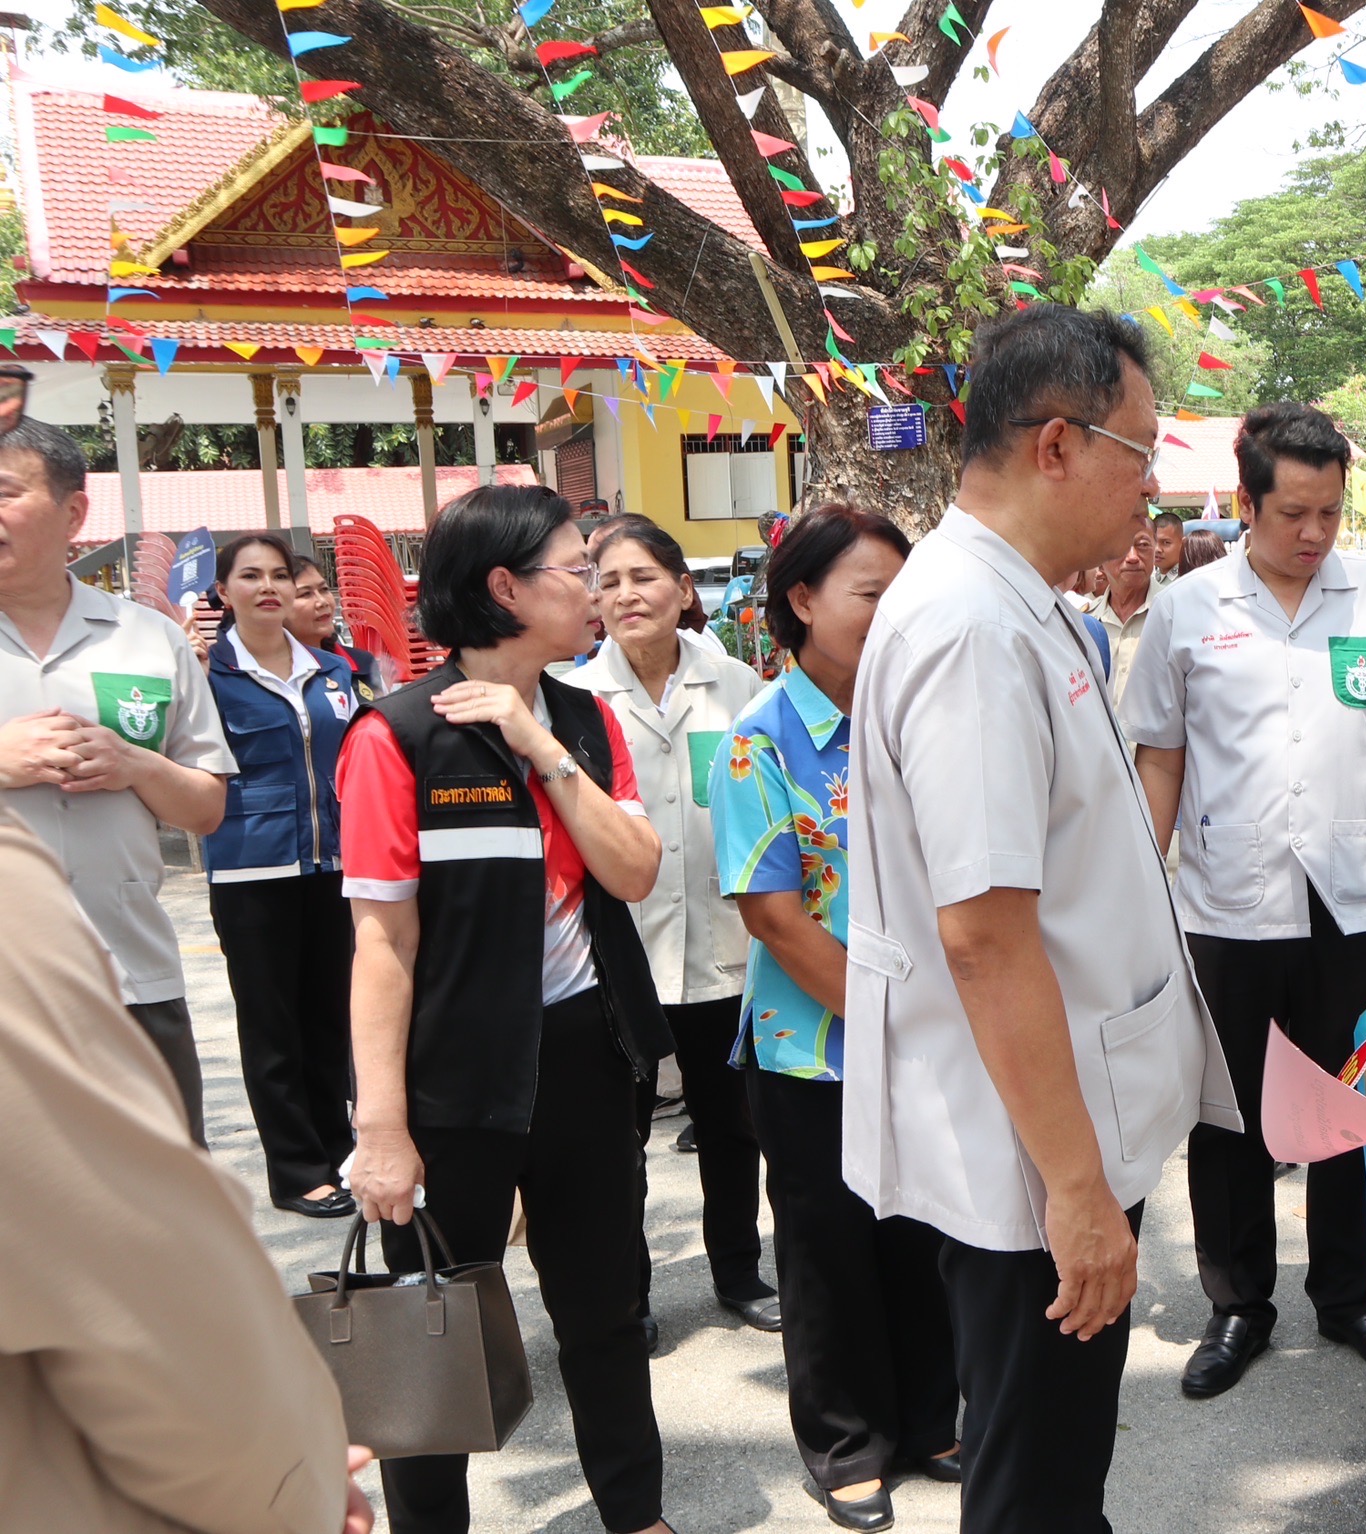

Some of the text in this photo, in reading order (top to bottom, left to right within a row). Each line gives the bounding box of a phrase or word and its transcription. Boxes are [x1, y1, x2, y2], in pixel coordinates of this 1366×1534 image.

[431, 779, 512, 805] กระทรวงการคลัง
